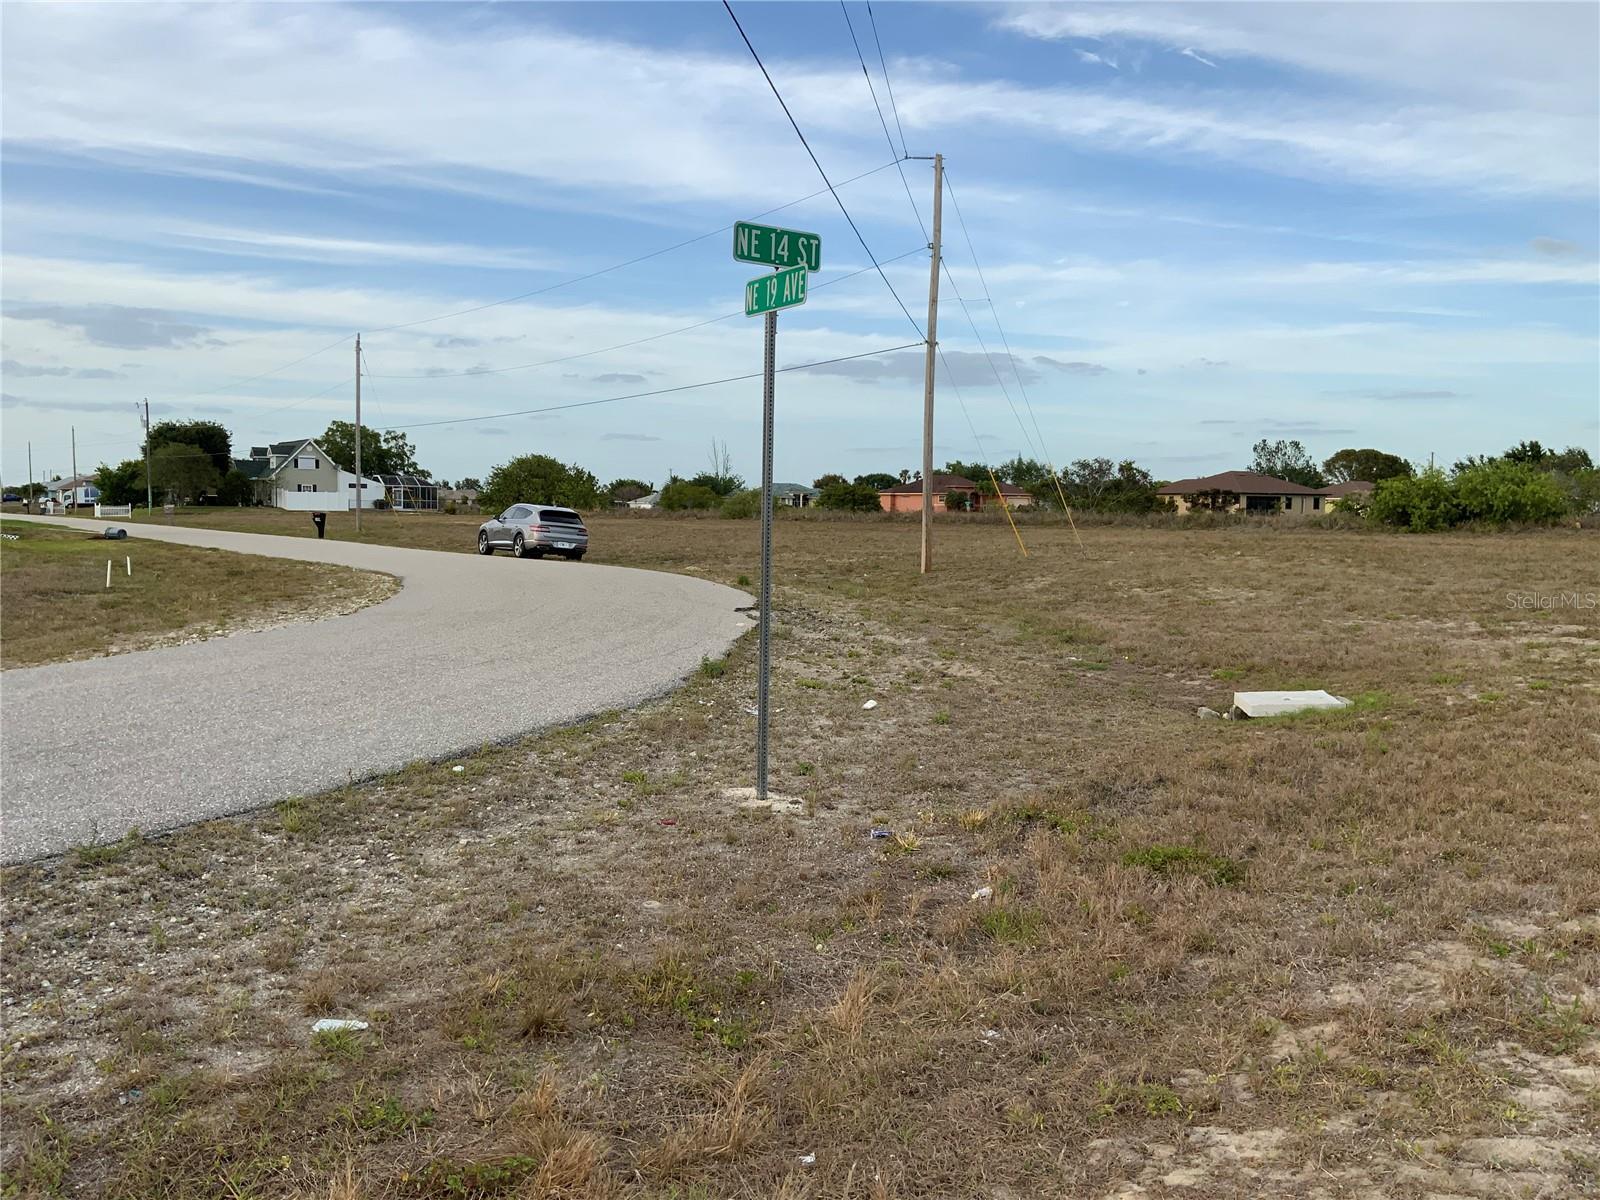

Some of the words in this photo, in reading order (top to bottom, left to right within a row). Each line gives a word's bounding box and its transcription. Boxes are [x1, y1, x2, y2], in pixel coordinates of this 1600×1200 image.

[737, 226, 761, 258] NE
[770, 233, 789, 263] 14
[797, 237, 819, 267] ST
[746, 283, 760, 312] NE
[766, 278, 778, 307] 19
[783, 270, 806, 303] AVE
